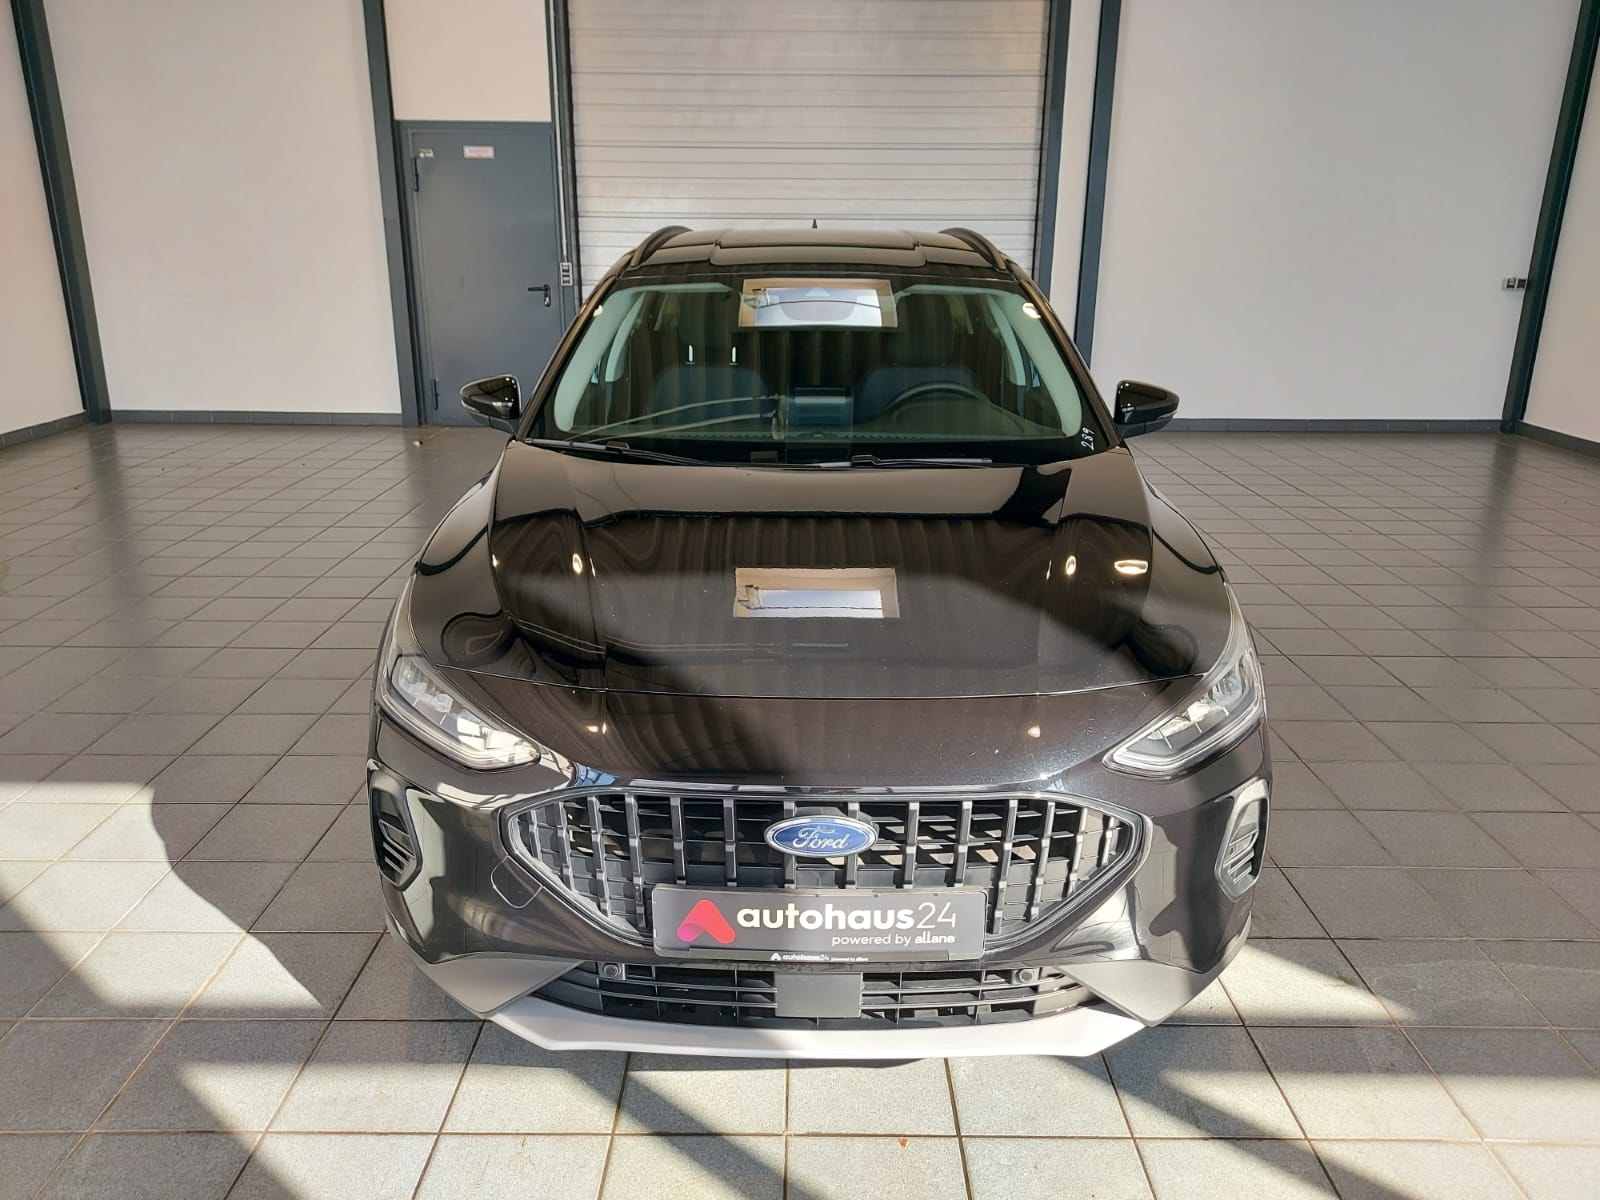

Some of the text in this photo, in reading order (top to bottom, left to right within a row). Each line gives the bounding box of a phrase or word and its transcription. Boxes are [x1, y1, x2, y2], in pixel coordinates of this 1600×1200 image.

[793, 826, 850, 849] Ford
[736, 902, 956, 930] autohaus24
[832, 931, 955, 947] powered by allane
